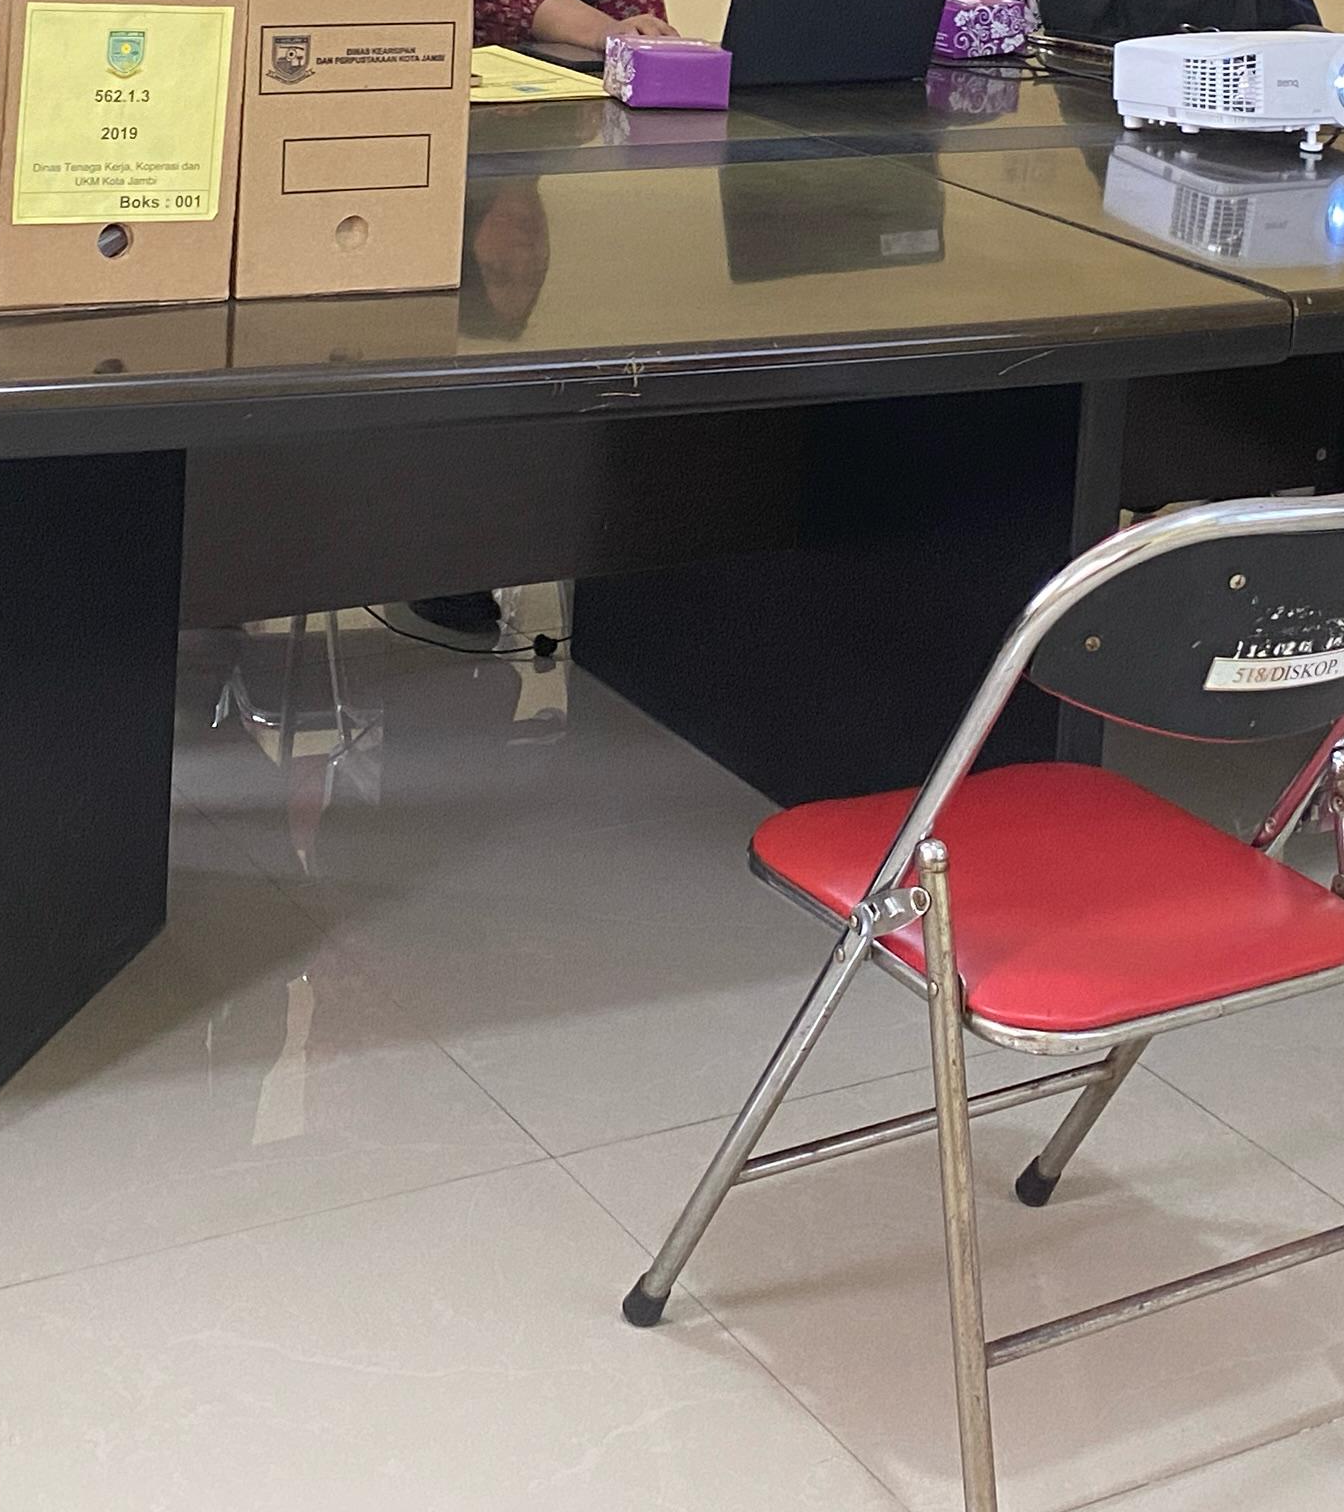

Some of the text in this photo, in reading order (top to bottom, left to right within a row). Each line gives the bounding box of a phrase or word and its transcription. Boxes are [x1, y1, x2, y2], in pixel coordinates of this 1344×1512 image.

[94, 89, 150, 103] 562.1.3
[101, 127, 138, 141] 2019
[32, 162, 61, 173] Dinas
[64, 162, 102, 174] Tenaga
[135, 161, 179, 173] Koperasi
[181, 161, 201, 172] dan
[75, 175, 157, 186] UKM Kota Jambi
[119, 195, 160, 209] Boks
[175, 194, 202, 208] 001
